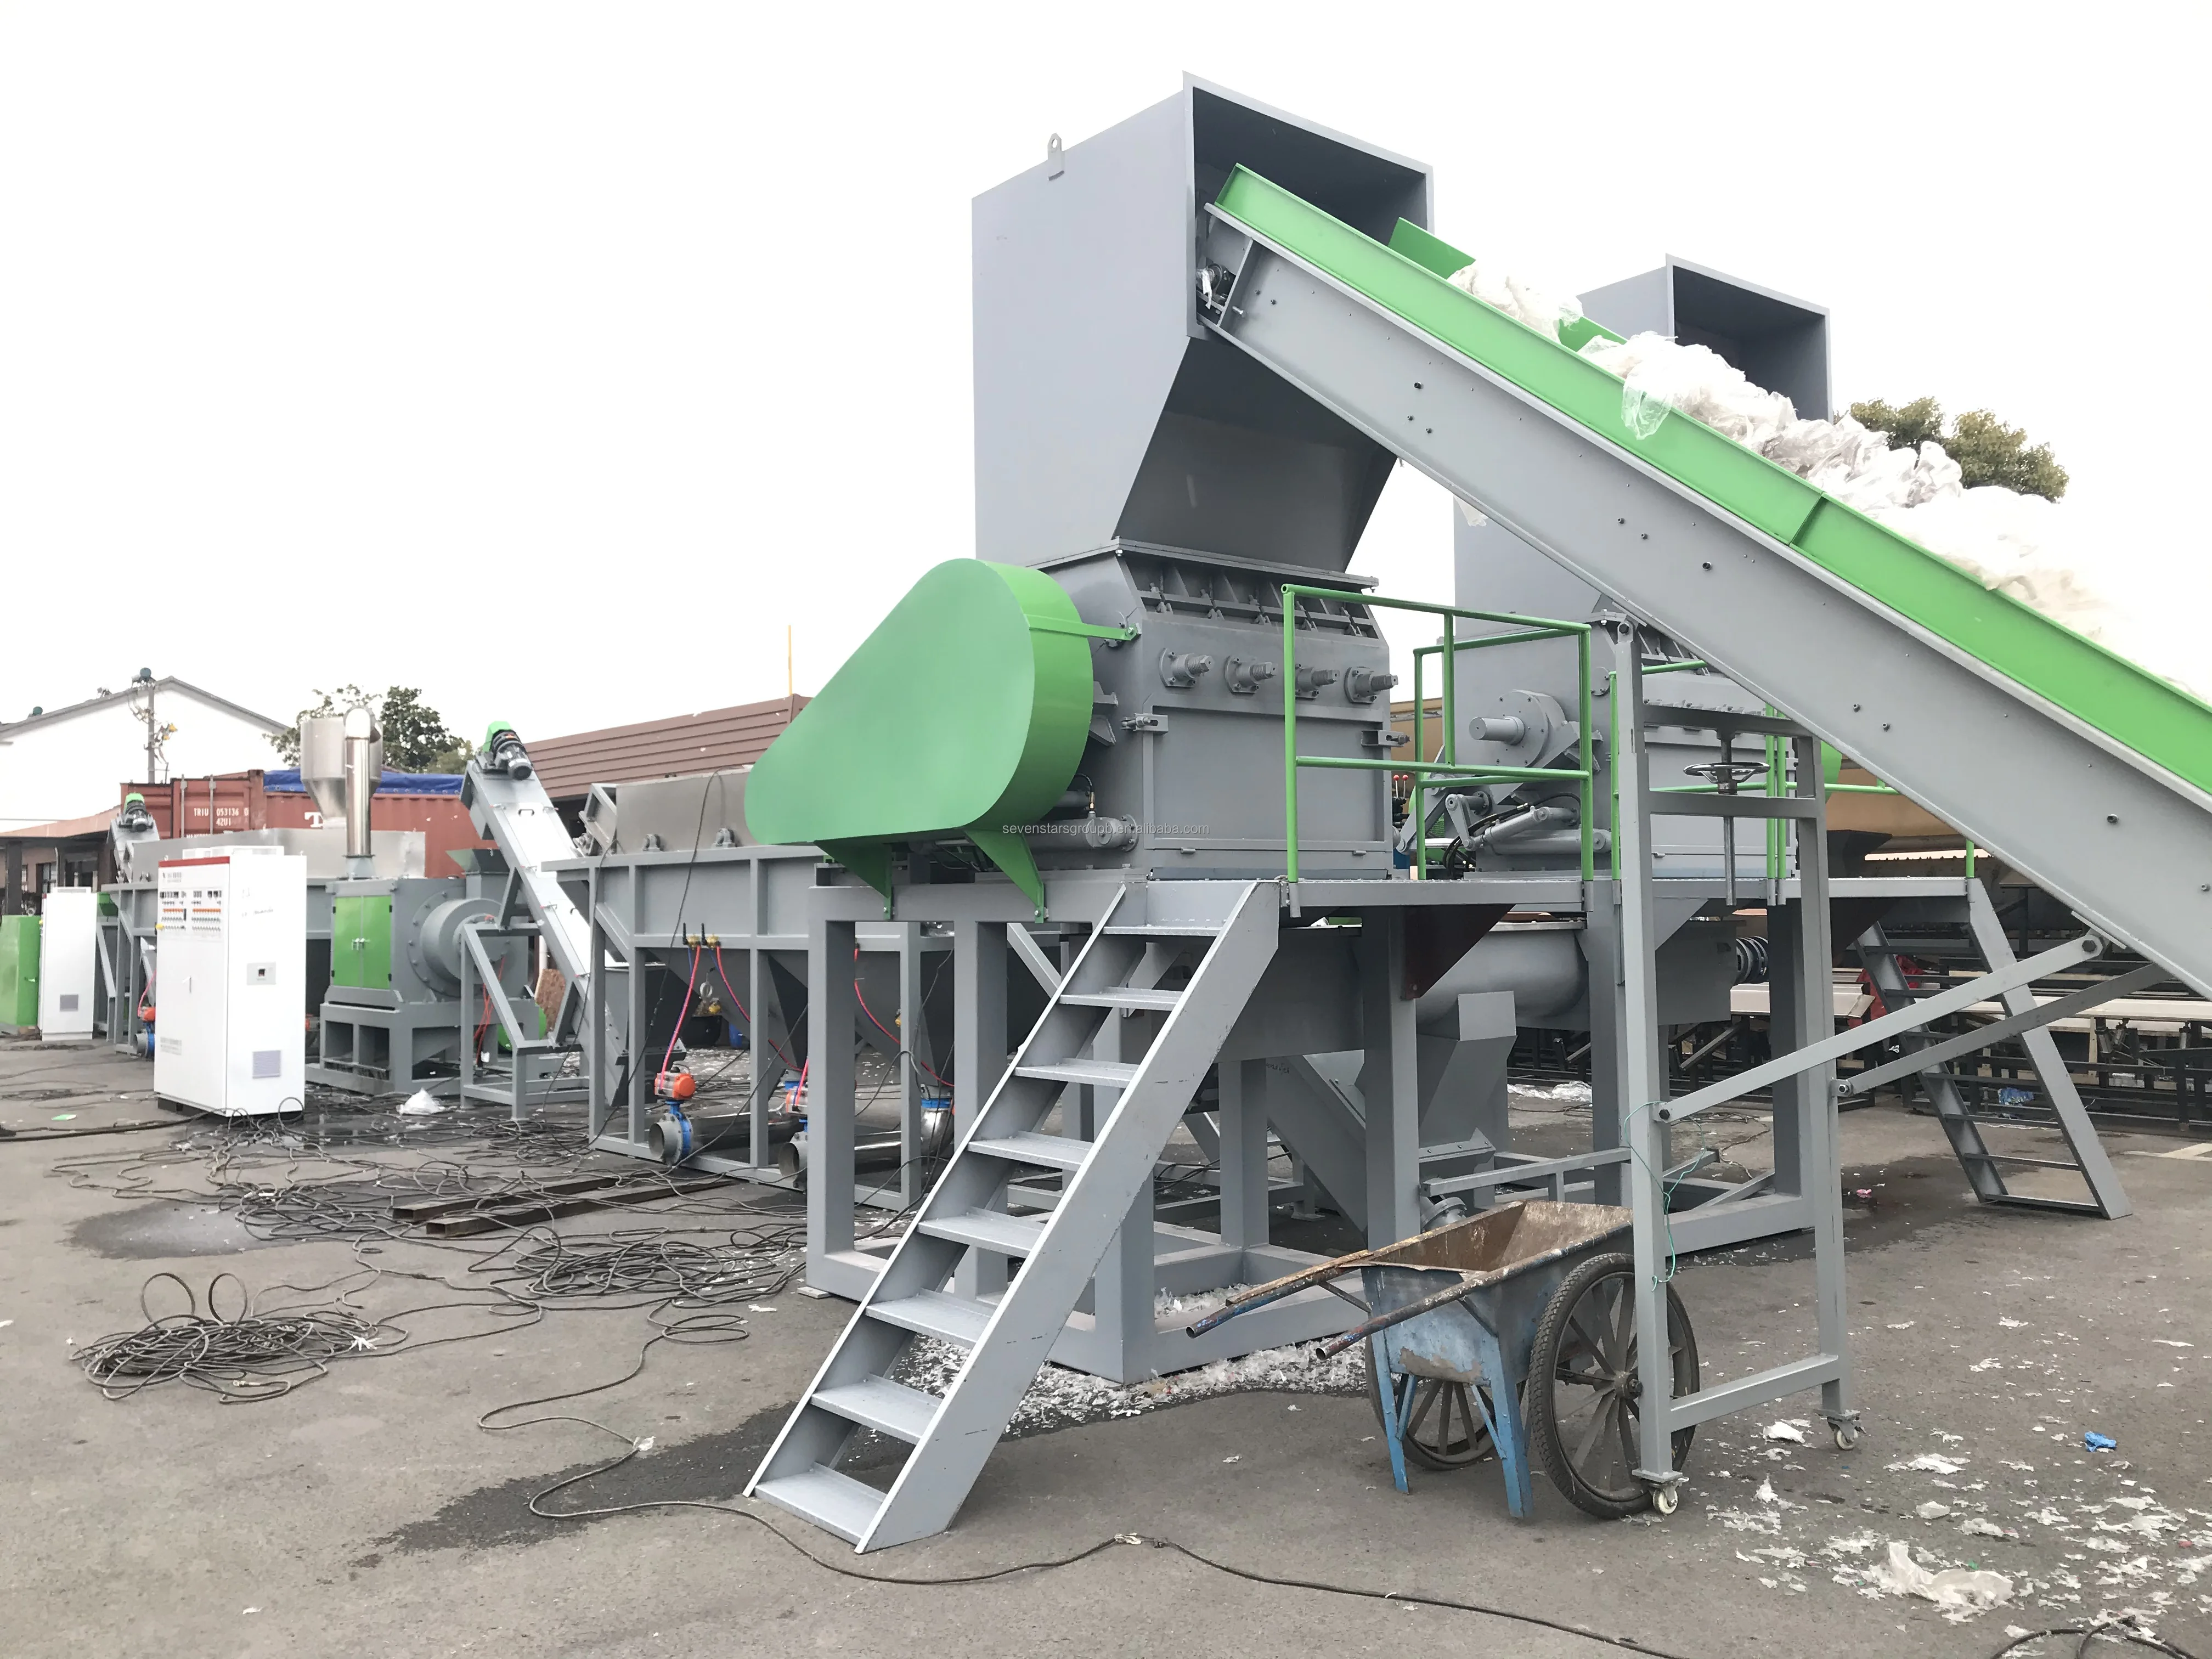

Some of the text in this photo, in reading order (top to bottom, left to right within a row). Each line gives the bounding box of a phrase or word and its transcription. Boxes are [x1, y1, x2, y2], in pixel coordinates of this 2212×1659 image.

[193, 808, 209, 816] TRIU
[216, 808, 239, 816] 053136
[216, 817, 231, 826] 42U1
